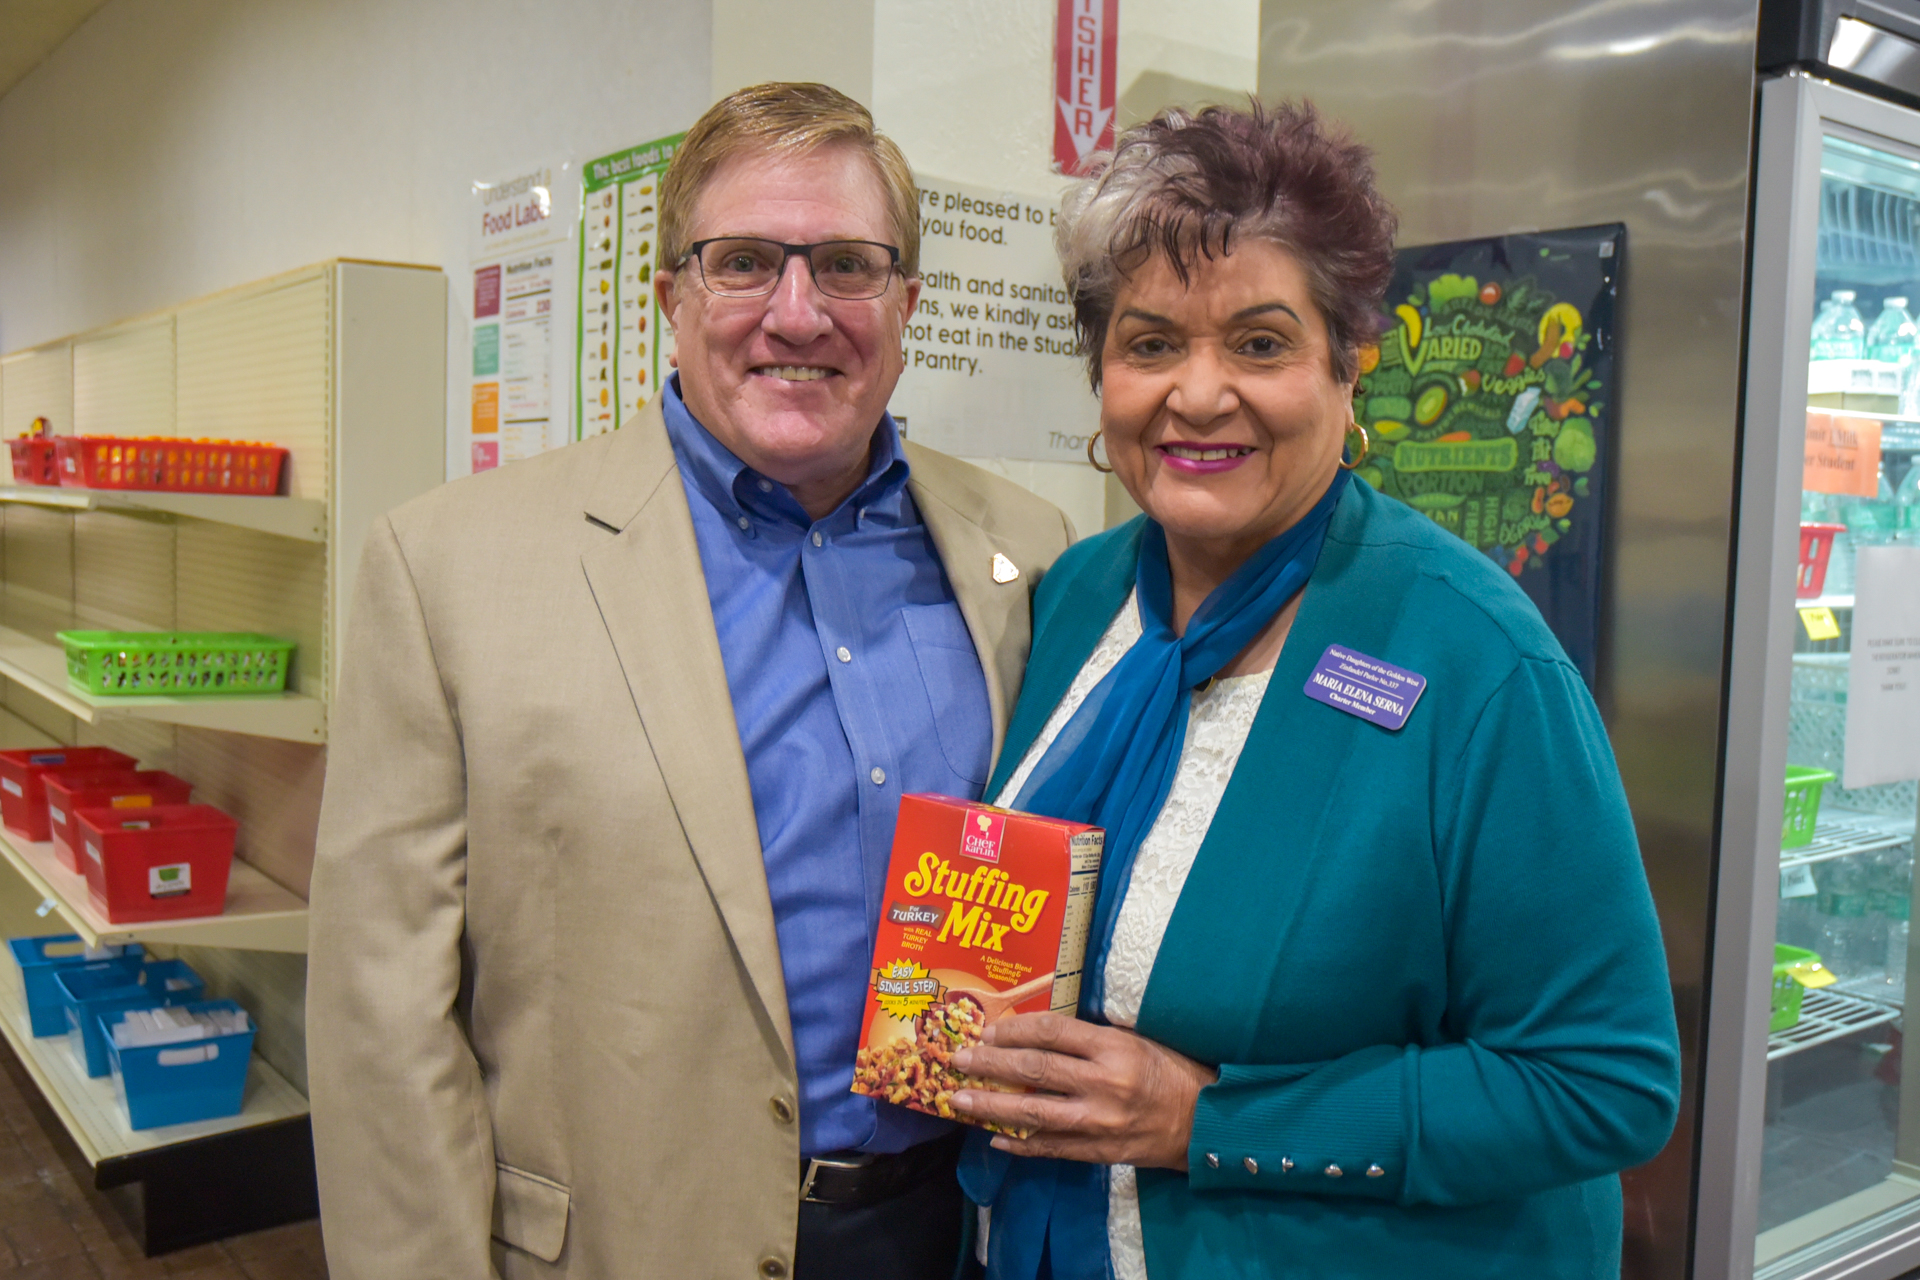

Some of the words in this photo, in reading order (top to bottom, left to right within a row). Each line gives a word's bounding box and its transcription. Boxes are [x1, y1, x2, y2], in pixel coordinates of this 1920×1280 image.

[593, 162, 610, 180] The
[610, 157, 631, 174] best
[631, 147, 661, 169] foods
[482, 205, 512, 236] Food
[515, 197, 551, 227] Lab
[918, 188, 940, 207] re
[944, 192, 1020, 222] pleased
[1026, 205, 1043, 225] to
[921, 217, 954, 237] you
[959, 219, 1008, 246] food.
[919, 270, 961, 292] ealth
[966, 277, 1004, 298] and
[914, 297, 945, 319] ns,
[950, 302, 979, 320] we
[985, 303, 1041, 332] kindly
[1046, 312, 1076, 332] ask
[902, 323, 932, 343] not
[938, 327, 971, 347] eat
[976, 327, 994, 348] in
[999, 330, 1028, 352] the
[1398, 322, 1483, 377] VARIED
[914, 350, 984, 378] Pantry.
[1481, 366, 1547, 396] Veggies
[1806, 427, 1826, 442] imit
[1837, 427, 1858, 447] Milk
[1398, 440, 1513, 472] NUTRIENTS
[1818, 451, 1855, 471] Student
[1401, 471, 1484, 495] PORTION
[1482, 496, 1499, 543] HIGH
[1329, 648, 1347, 661] Native
[1345, 655, 1371, 670] Daughters
[1371, 664, 1379, 672] of
[1377, 667, 1387, 675] the
[1386, 670, 1406, 683] Golden
[1406, 677, 1420, 688] West
[1339, 662, 1363, 677] Zinfandel
[1363, 672, 1380, 683] Parlor
[1312, 672, 1343, 693] MARIA
[1342, 683, 1373, 705] ELENA
[1372, 695, 1404, 717] SERNA
[1329, 692, 1351, 706] Charter
[1351, 701, 1377, 716] Member
[1091, 833, 1103, 846] Facts
[903, 851, 1050, 934] Stuffing
[892, 909, 939, 924] TURKEY
[936, 900, 1011, 953] Mix
[901, 940, 924, 952] BROTH
[902, 932, 929, 945] TURKEY
[914, 927, 933, 938] REAL
[891, 965, 915, 978] EASY
[980, 954, 986, 962] A
[986, 956, 1014, 969] Delicious
[1014, 963, 1032, 973] Blend
[985, 964, 993, 972] of
[992, 965, 1016, 978] Stuffing
[879, 980, 910, 995] SINGLE
[912, 981, 937, 993] STEP!
[987, 971, 1019, 986] Seasoning
